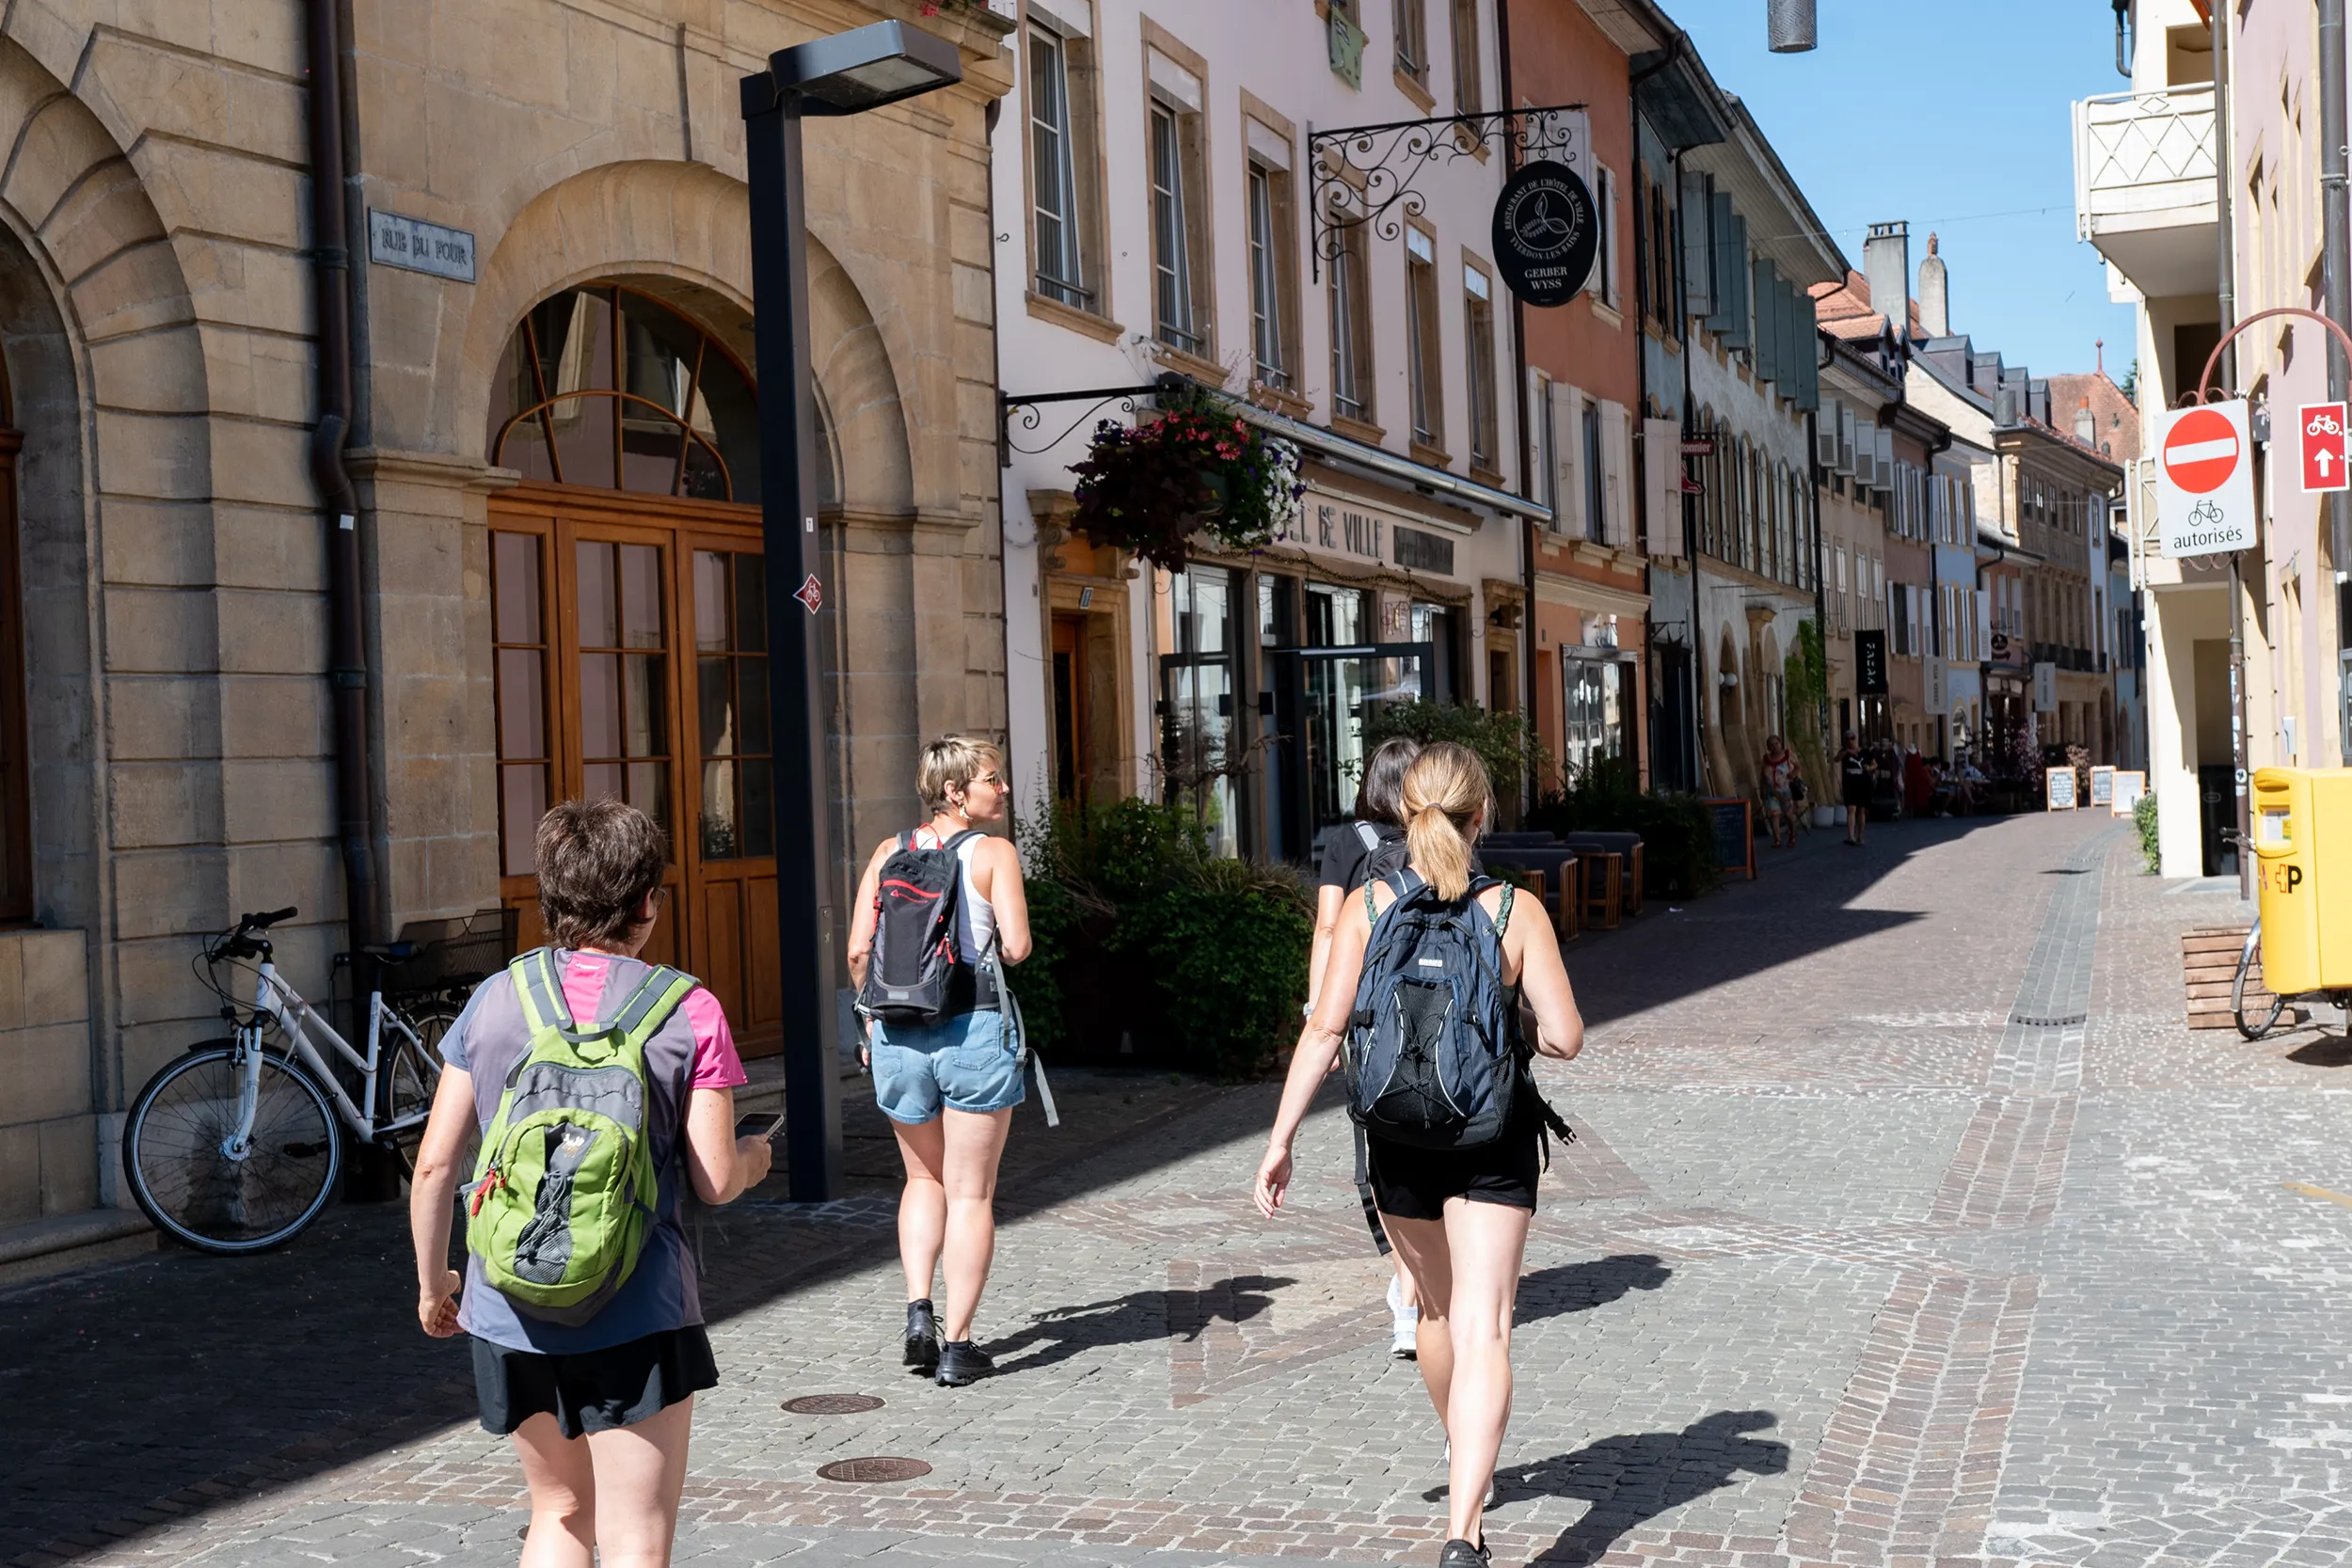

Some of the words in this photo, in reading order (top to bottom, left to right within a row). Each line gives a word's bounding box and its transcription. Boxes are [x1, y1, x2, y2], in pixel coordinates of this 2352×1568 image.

[1504, 185, 1527, 230] RESTAURANT
[1528, 180, 1539, 190] DE
[1575, 201, 1584, 225] VILLE
[381, 229, 407, 252] RUE
[412, 234, 430, 259] DU
[436, 240, 468, 265] FOUR
[1524, 266, 1568, 279] GERBER
[1530, 278, 1563, 291] WYSS
[1343, 512, 1384, 559] VILLE
[2173, 525, 2243, 549] autorisés
